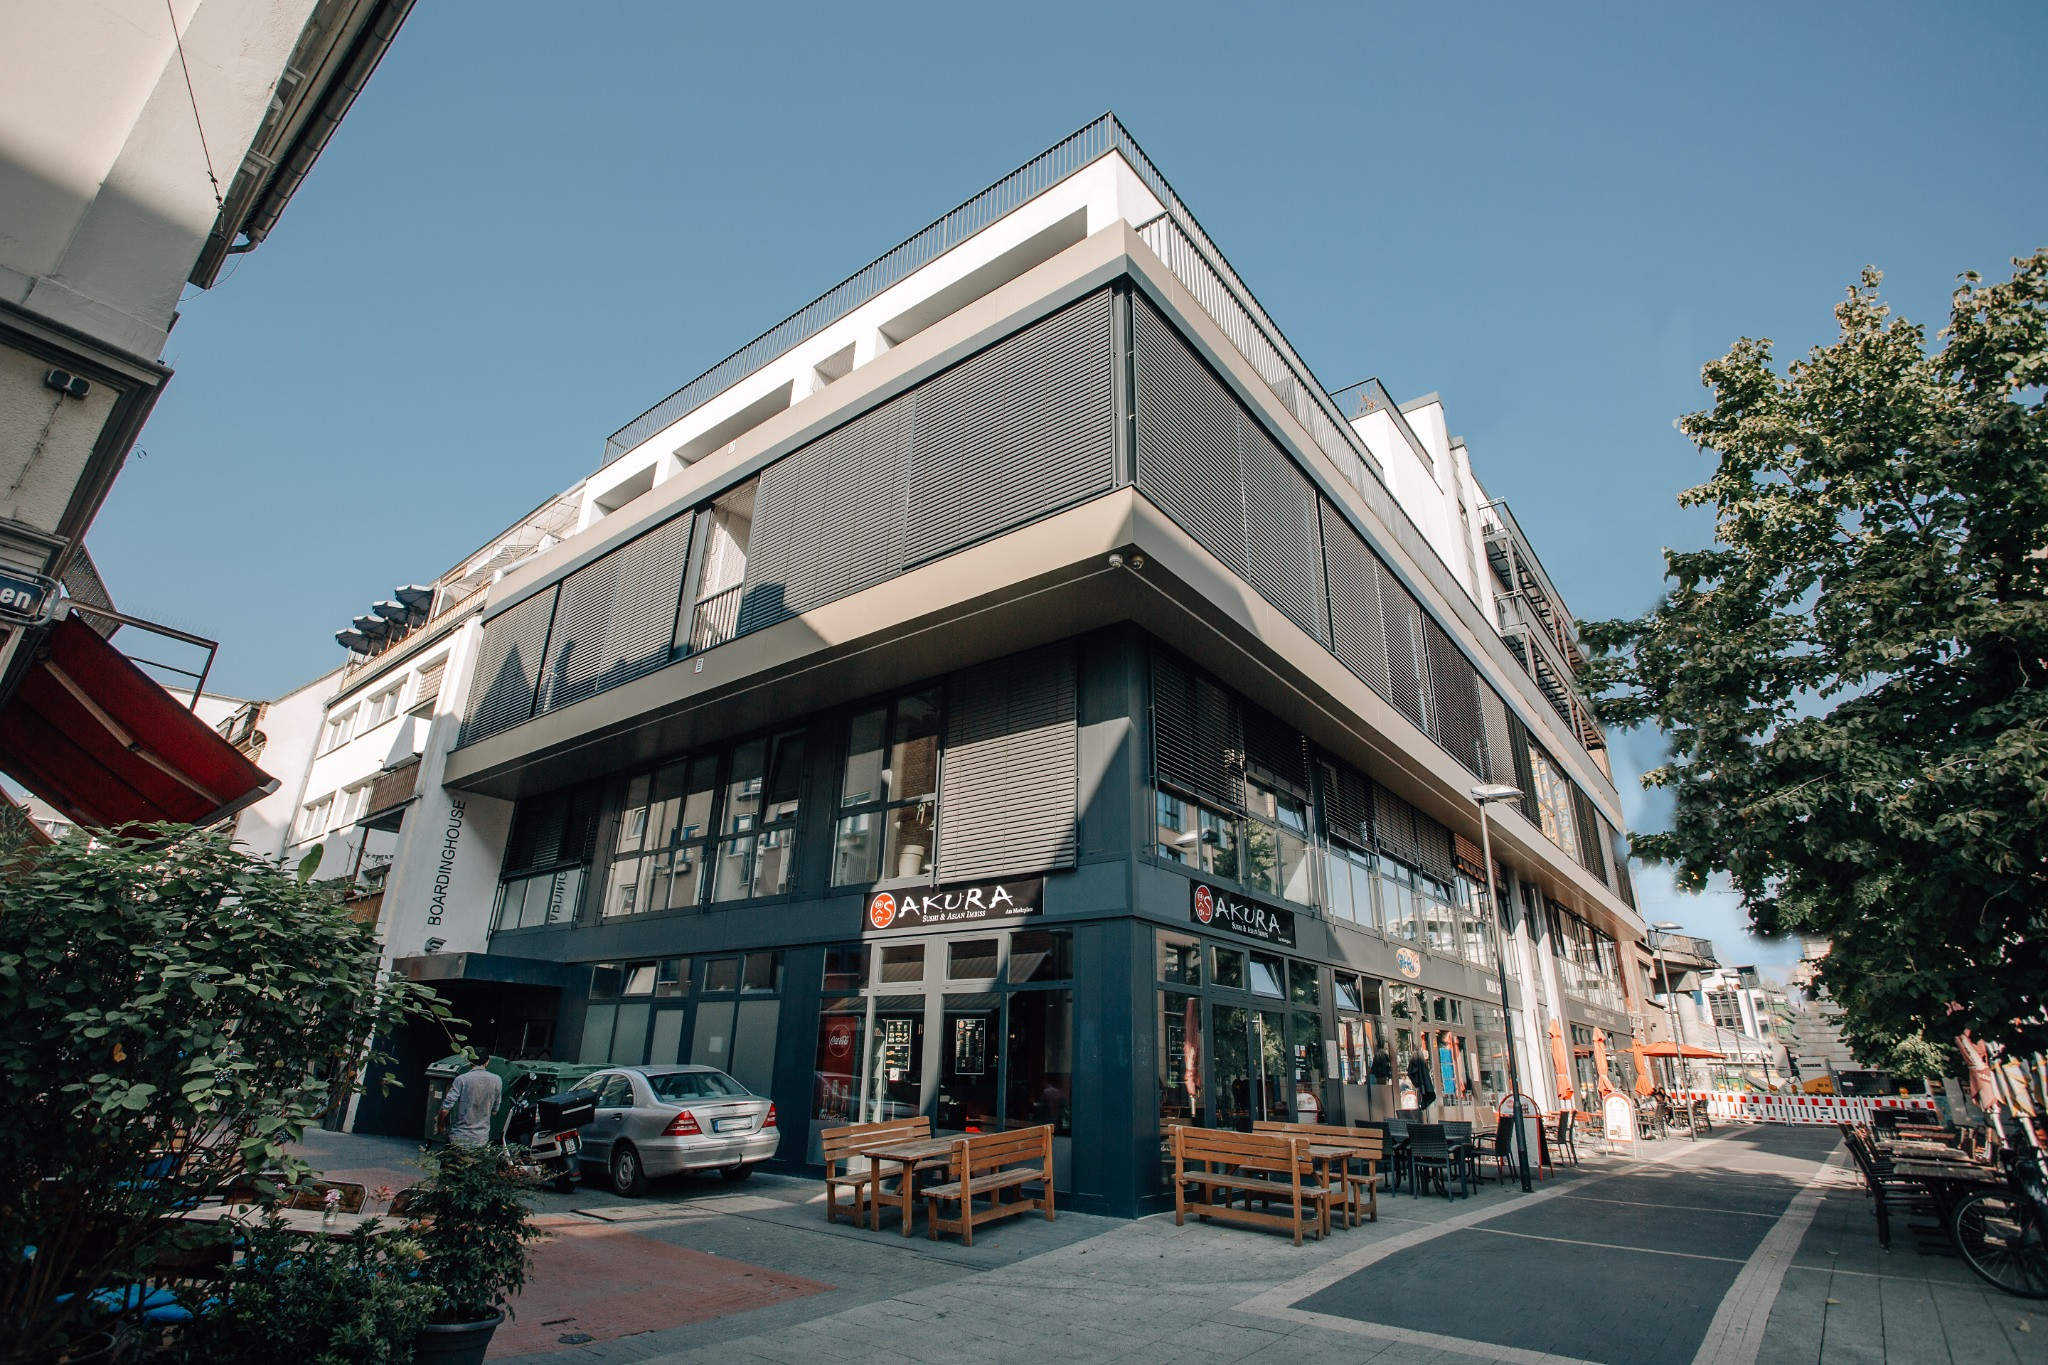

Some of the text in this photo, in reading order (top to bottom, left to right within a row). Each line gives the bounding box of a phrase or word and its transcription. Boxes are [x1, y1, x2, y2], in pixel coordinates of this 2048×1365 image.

[427, 799, 466, 926] BOARDINGHOUSE
[922, 915, 939, 923] SUSHI
[947, 912, 965, 920] ASIAN
[966, 910, 986, 918] IMBISS
